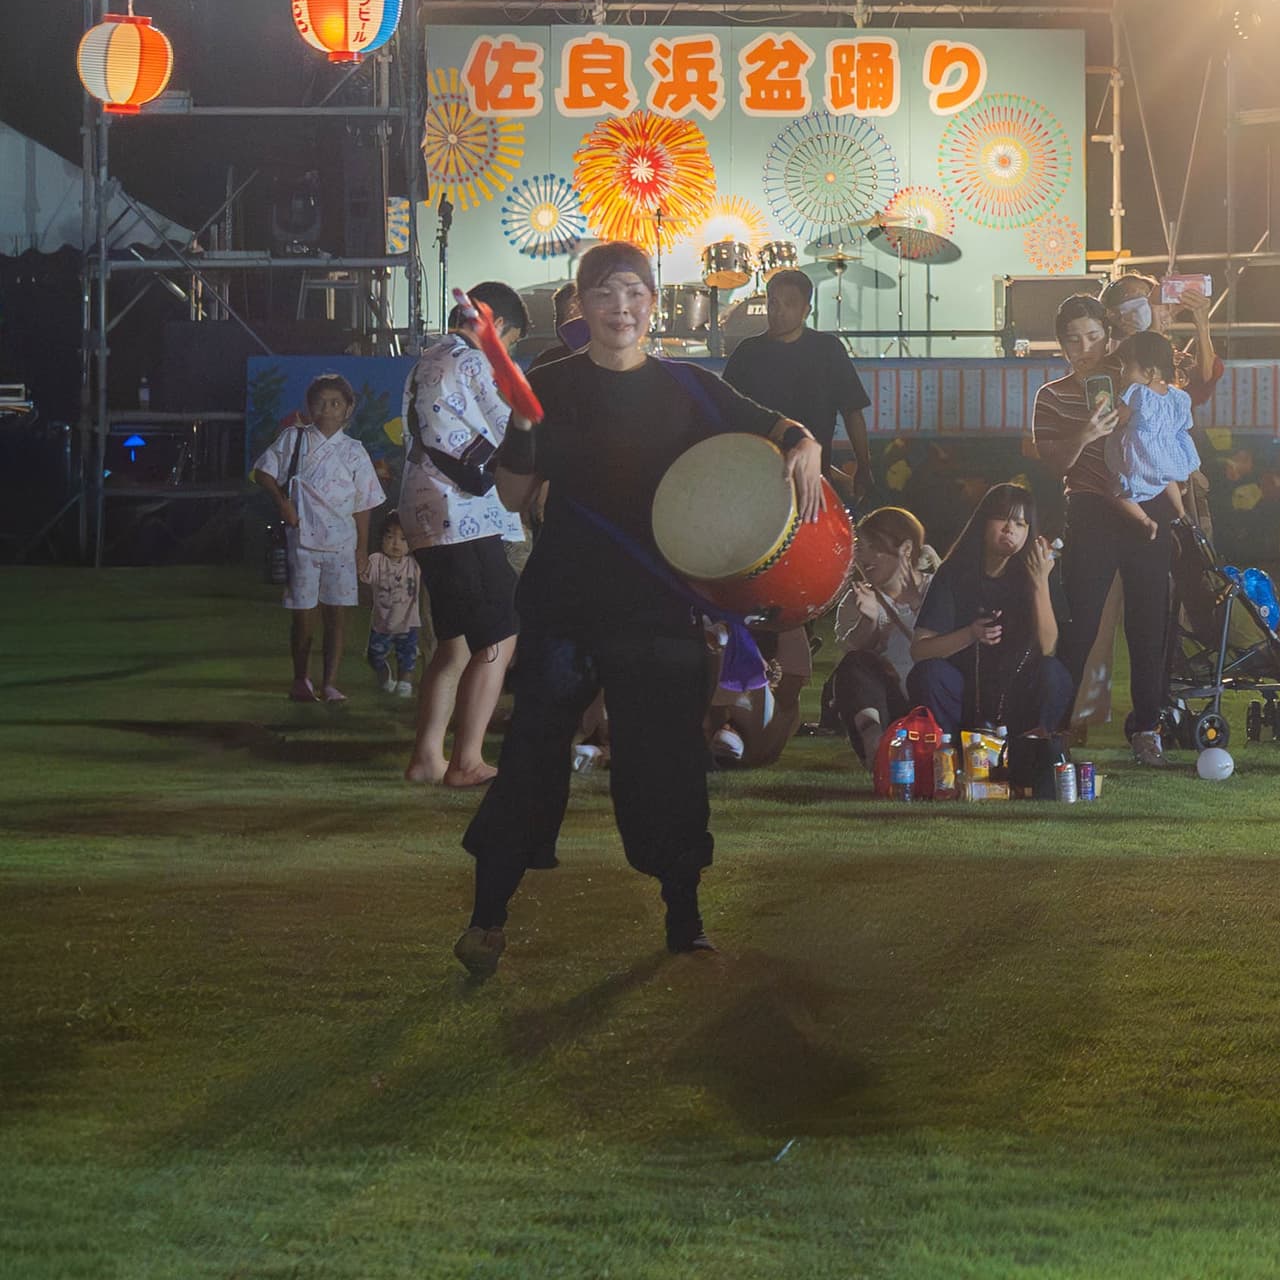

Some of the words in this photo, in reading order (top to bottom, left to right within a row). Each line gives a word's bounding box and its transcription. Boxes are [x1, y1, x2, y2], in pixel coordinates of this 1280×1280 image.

[467, 38, 981, 112] 佐良浜盆踊り
